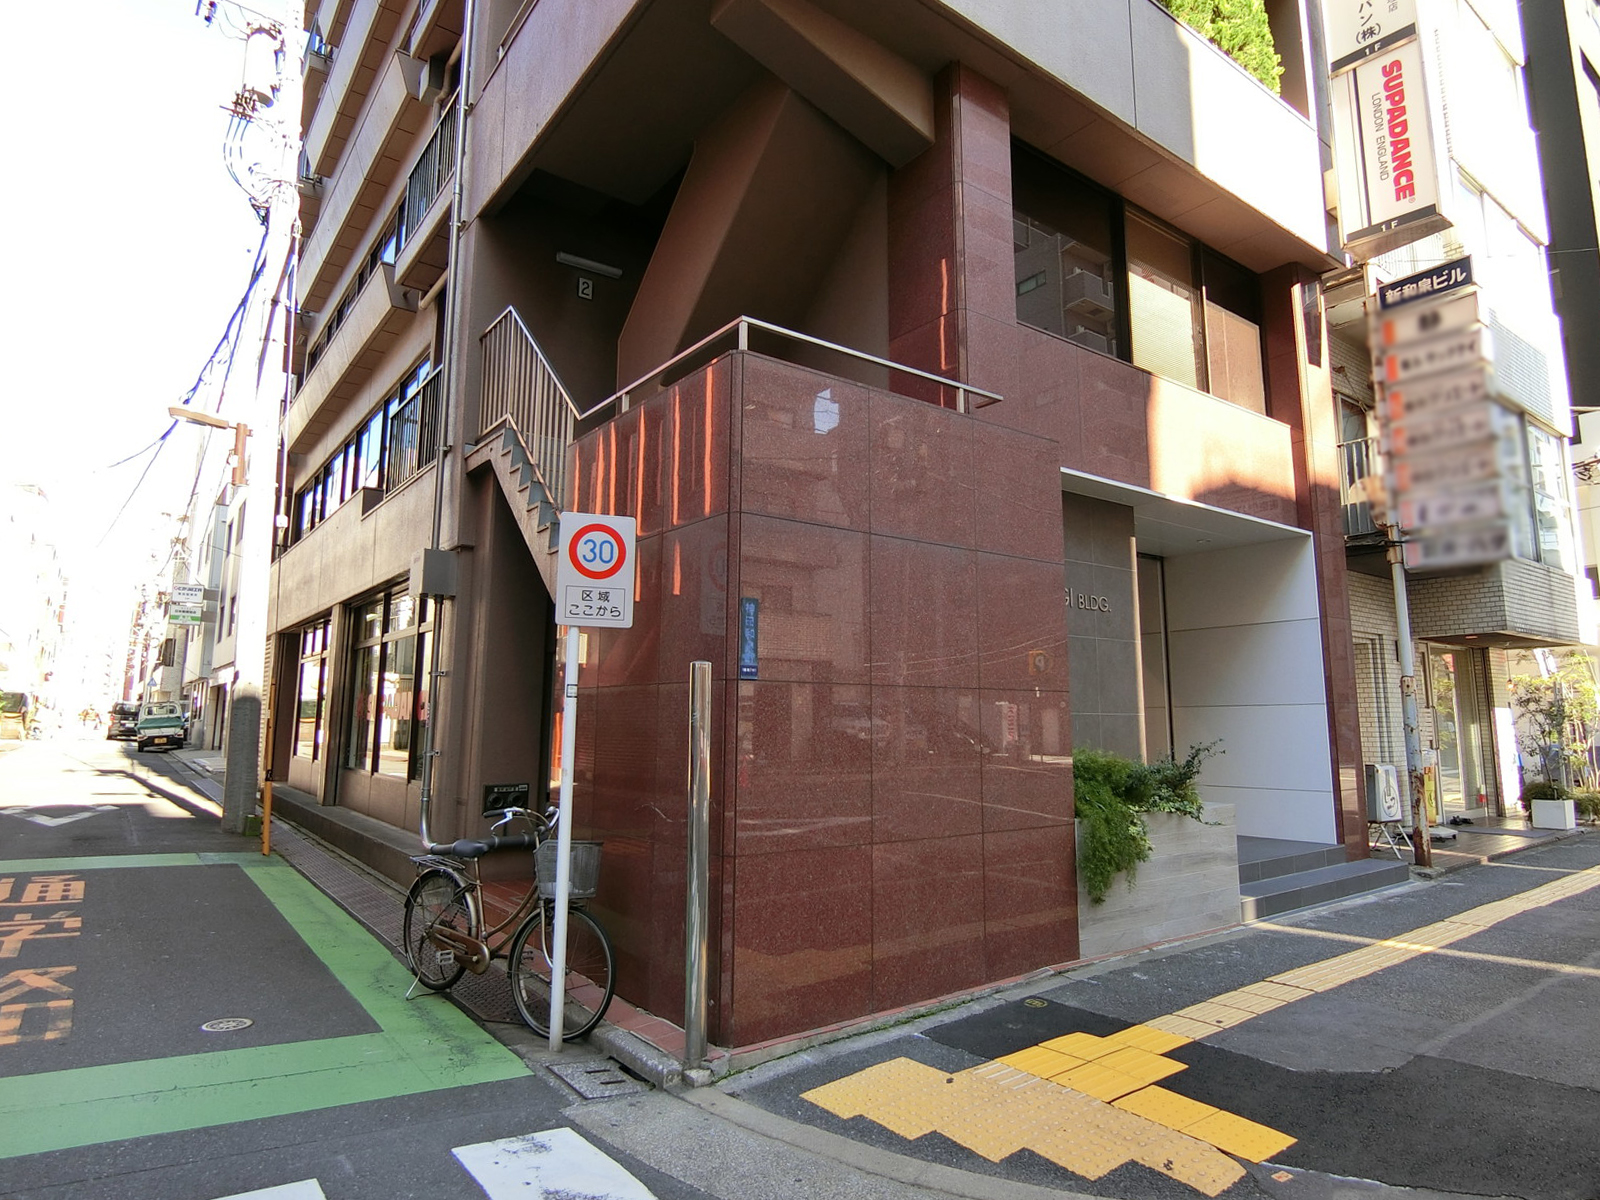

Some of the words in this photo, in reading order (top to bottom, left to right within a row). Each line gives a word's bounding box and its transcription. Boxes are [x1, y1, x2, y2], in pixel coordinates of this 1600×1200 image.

[1372, 93, 1384, 132] LONDON
[1382, 59, 1415, 202] SUPADANCE
[1376, 135, 1389, 181] ENGLAND
[581, 281, 590, 296] 2
[582, 538, 614, 564] 30
[582, 590, 610, 602] 区域
[1078, 593, 1112, 612] BLDG.
[569, 604, 621, 617] ここから
